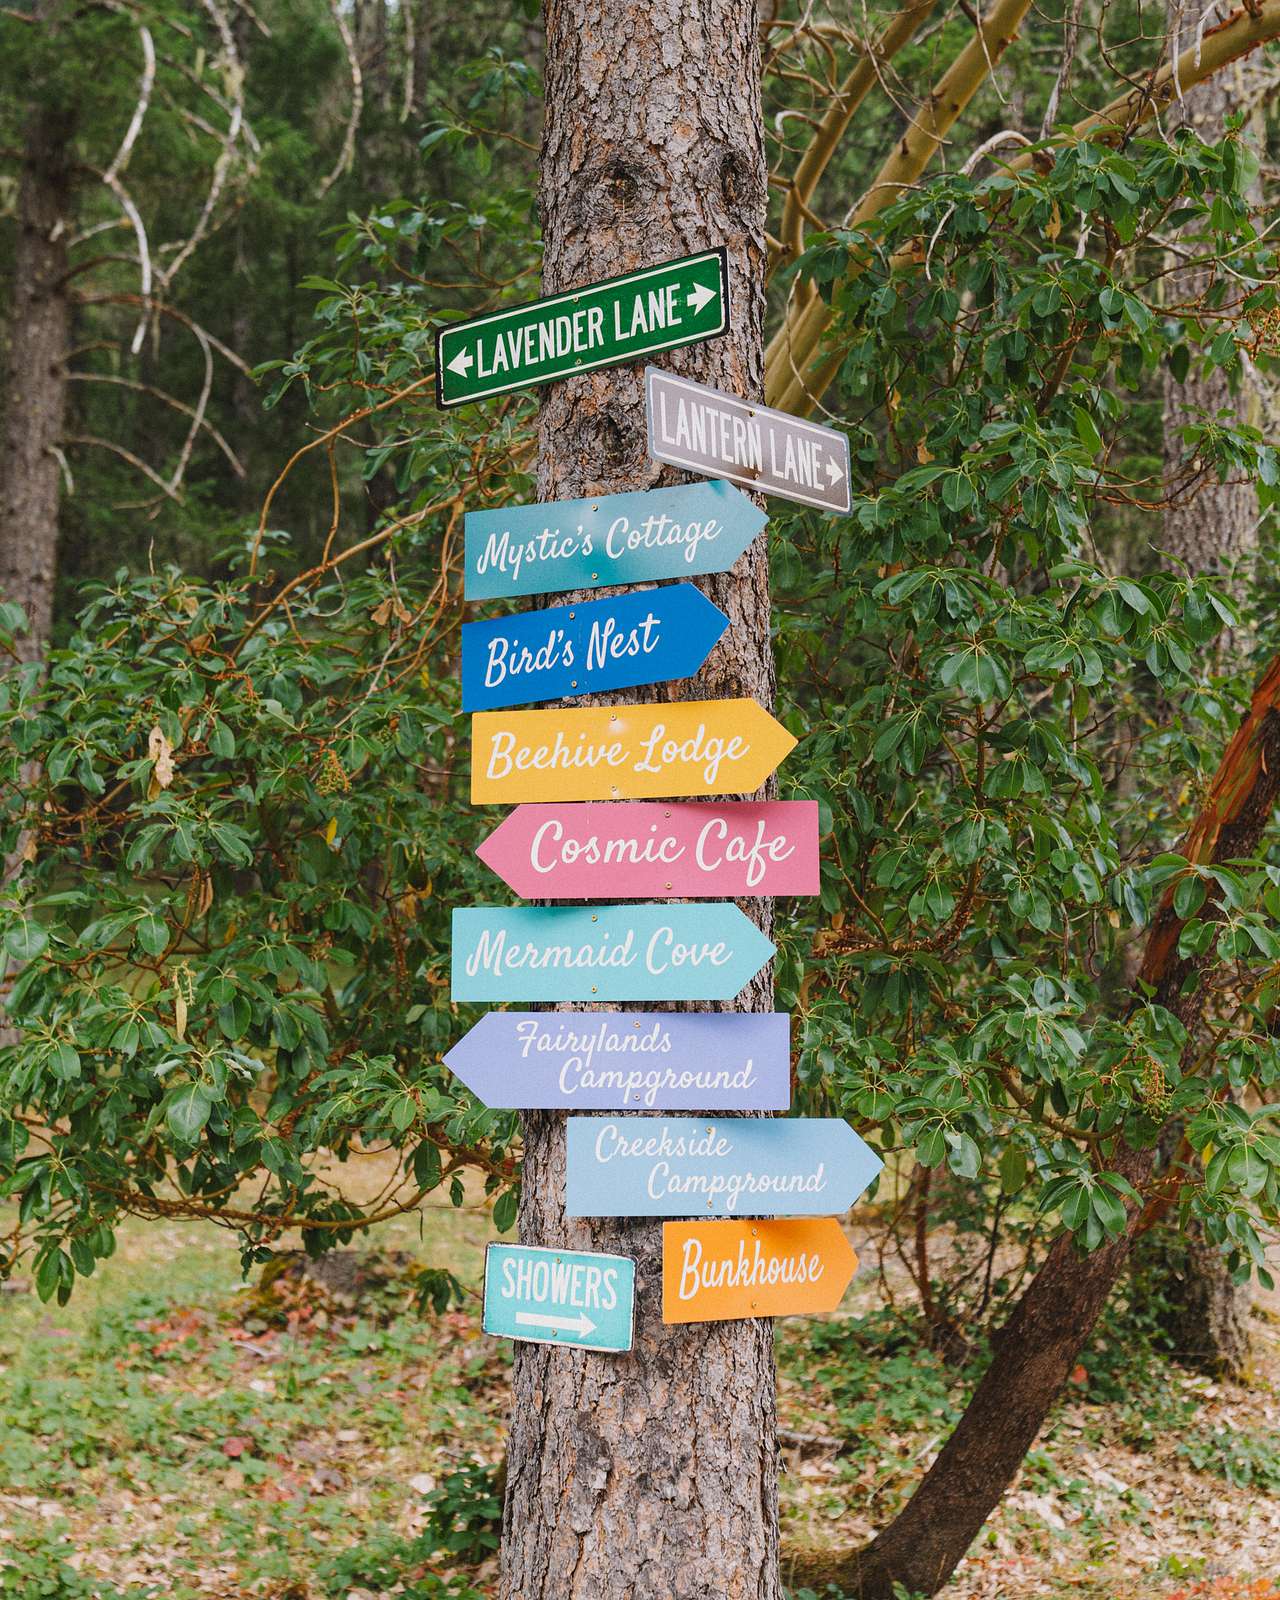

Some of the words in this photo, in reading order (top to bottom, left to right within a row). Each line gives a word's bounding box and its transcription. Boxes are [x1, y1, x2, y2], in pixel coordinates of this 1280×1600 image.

[477, 306, 604, 378] LAVENDER
[613, 283, 681, 340] LANE
[659, 391, 763, 472] LANTERN
[769, 429, 825, 491] LANE
[476, 525, 595, 580] Mystic's
[605, 513, 724, 562] Cottage
[484, 630, 574, 688] Bird's
[586, 613, 661, 671] Nest
[486, 732, 630, 780] Beehive
[634, 724, 750, 785] Lodge
[530, 820, 686, 874] Cosmic
[695, 818, 795, 888] Cafe
[466, 929, 639, 977] Mermaid
[646, 926, 734, 974] Cove
[515, 1020, 671, 1066] Fairylands
[558, 1057, 758, 1107] Campground
[595, 1125, 733, 1163] Creekside
[647, 1162, 827, 1211] Campground
[501, 1257, 617, 1310] SHOWERS
[679, 1238, 824, 1300] Bunkhouse
